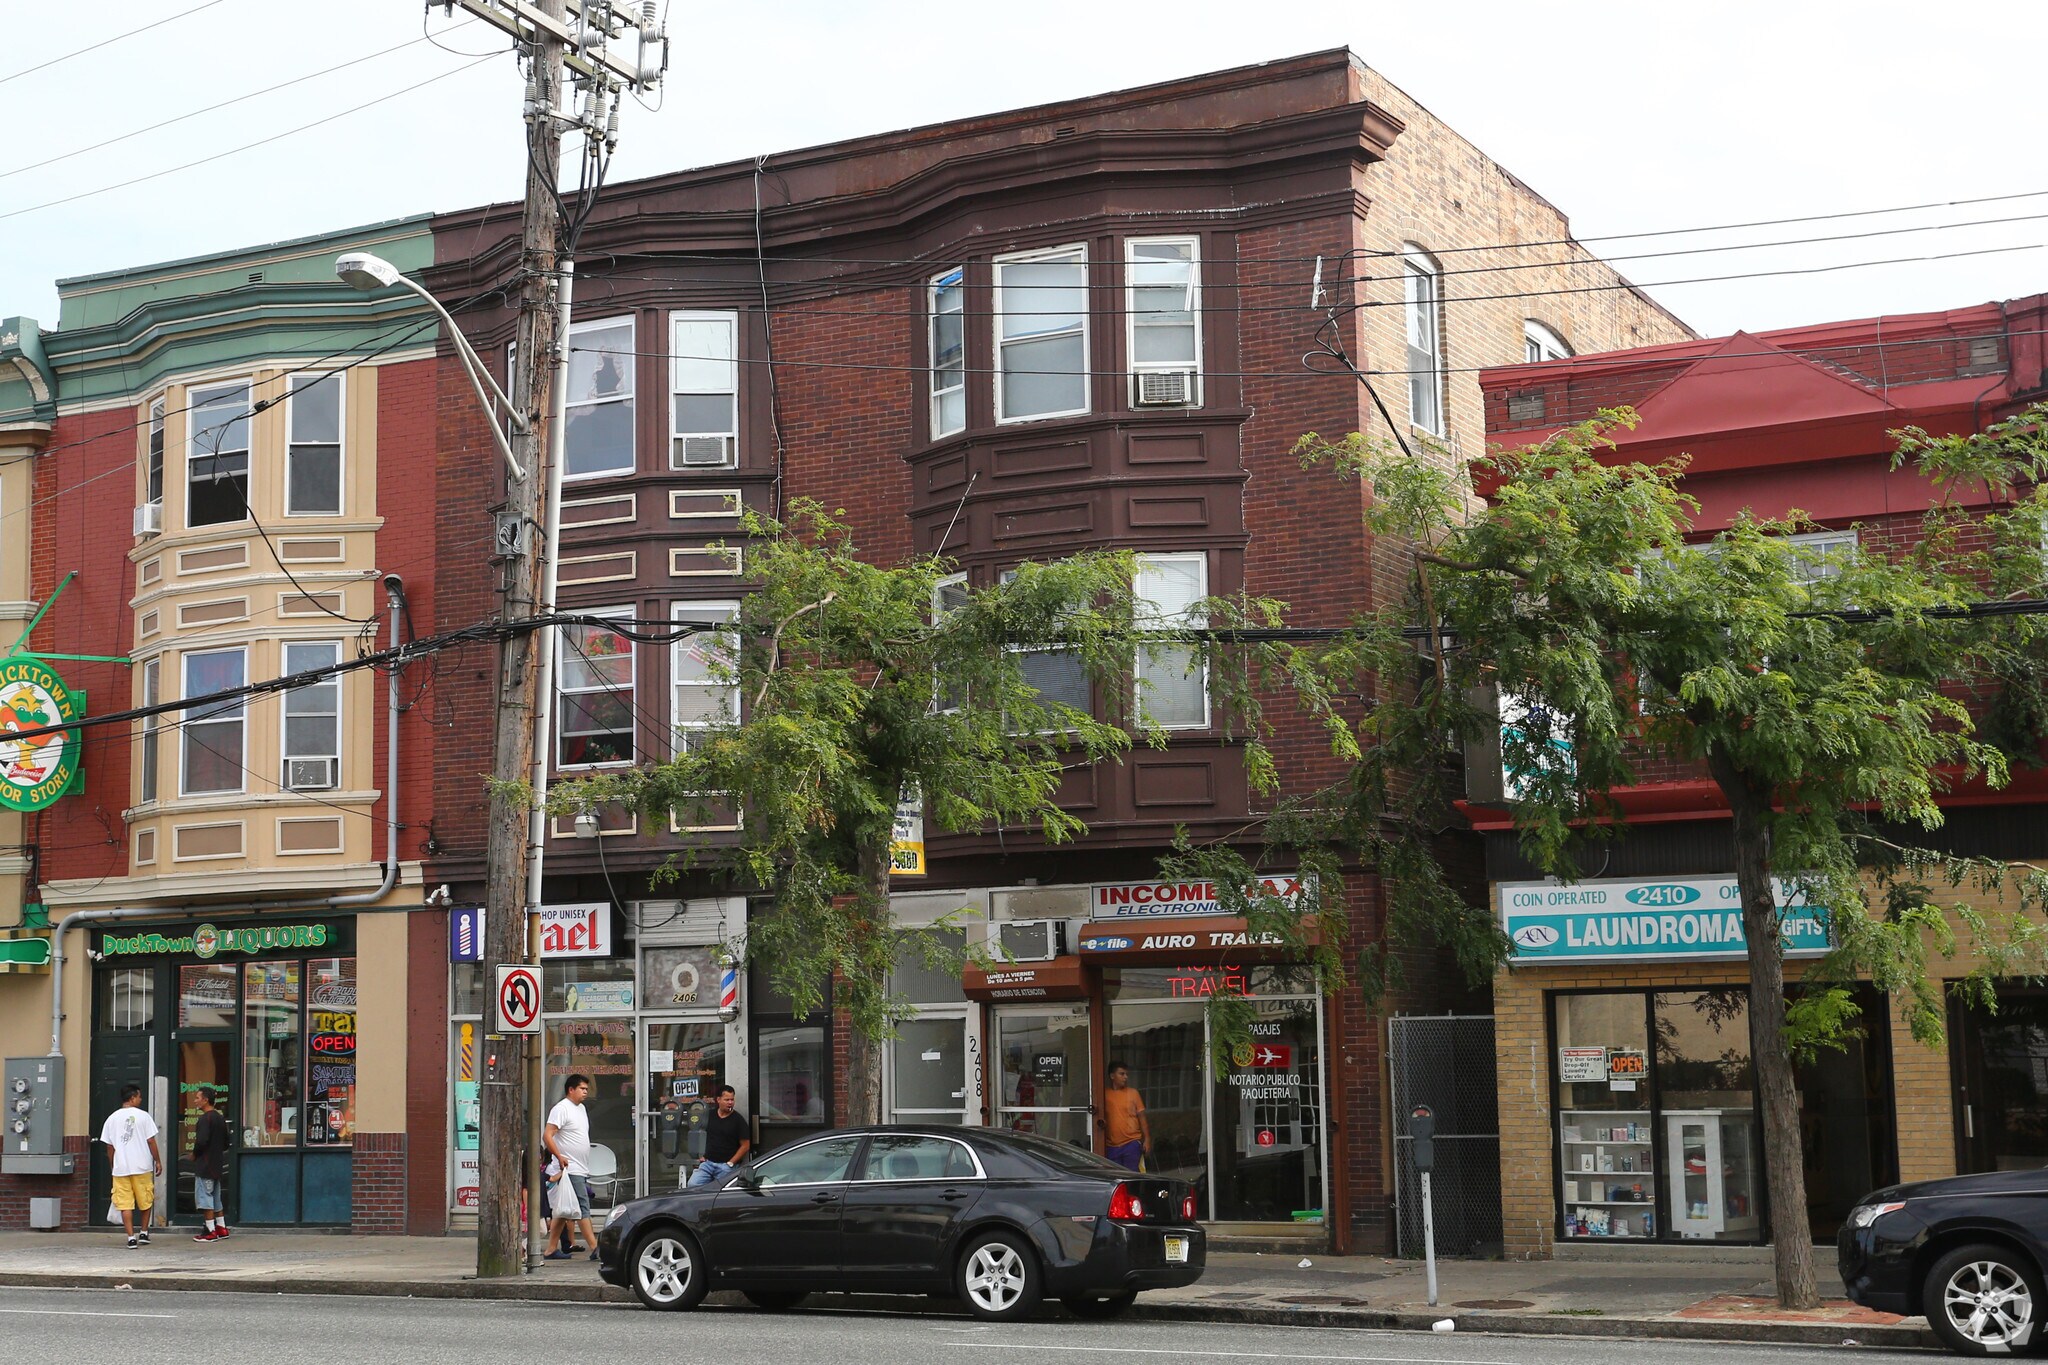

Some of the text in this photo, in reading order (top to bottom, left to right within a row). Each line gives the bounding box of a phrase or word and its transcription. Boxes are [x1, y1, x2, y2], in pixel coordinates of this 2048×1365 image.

[30, 764, 69, 803] STORE
[1513, 885, 1741, 907] COIN OPERATED 2410 OP
[541, 909, 586, 920] HOP UNISEX
[1566, 913, 1744, 947] LAUNDROMA
[1781, 918, 1823, 936] GIFTS
[103, 924, 326, 956] DuckTown LIQUORS
[1141, 935, 1196, 949] AURO
[672, 993, 697, 1003] 2406
[990, 989, 1014, 998] HORARIO
[1021, 988, 1046, 996] ATENCION
[320, 995, 356, 1005] LIGH
[312, 1012, 356, 1033] Ta
[1248, 1023, 1281, 1036] PASAJES
[313, 1036, 355, 1051] OPEN
[1039, 1056, 1062, 1065] OPEN
[1612, 1057, 1643, 1072] OPEN
[1229, 1073, 1301, 1086] NOTARIO PUBLICO
[675, 1083, 697, 1095] OPEN
[1241, 1087, 1291, 1100] PAQUETERIA
